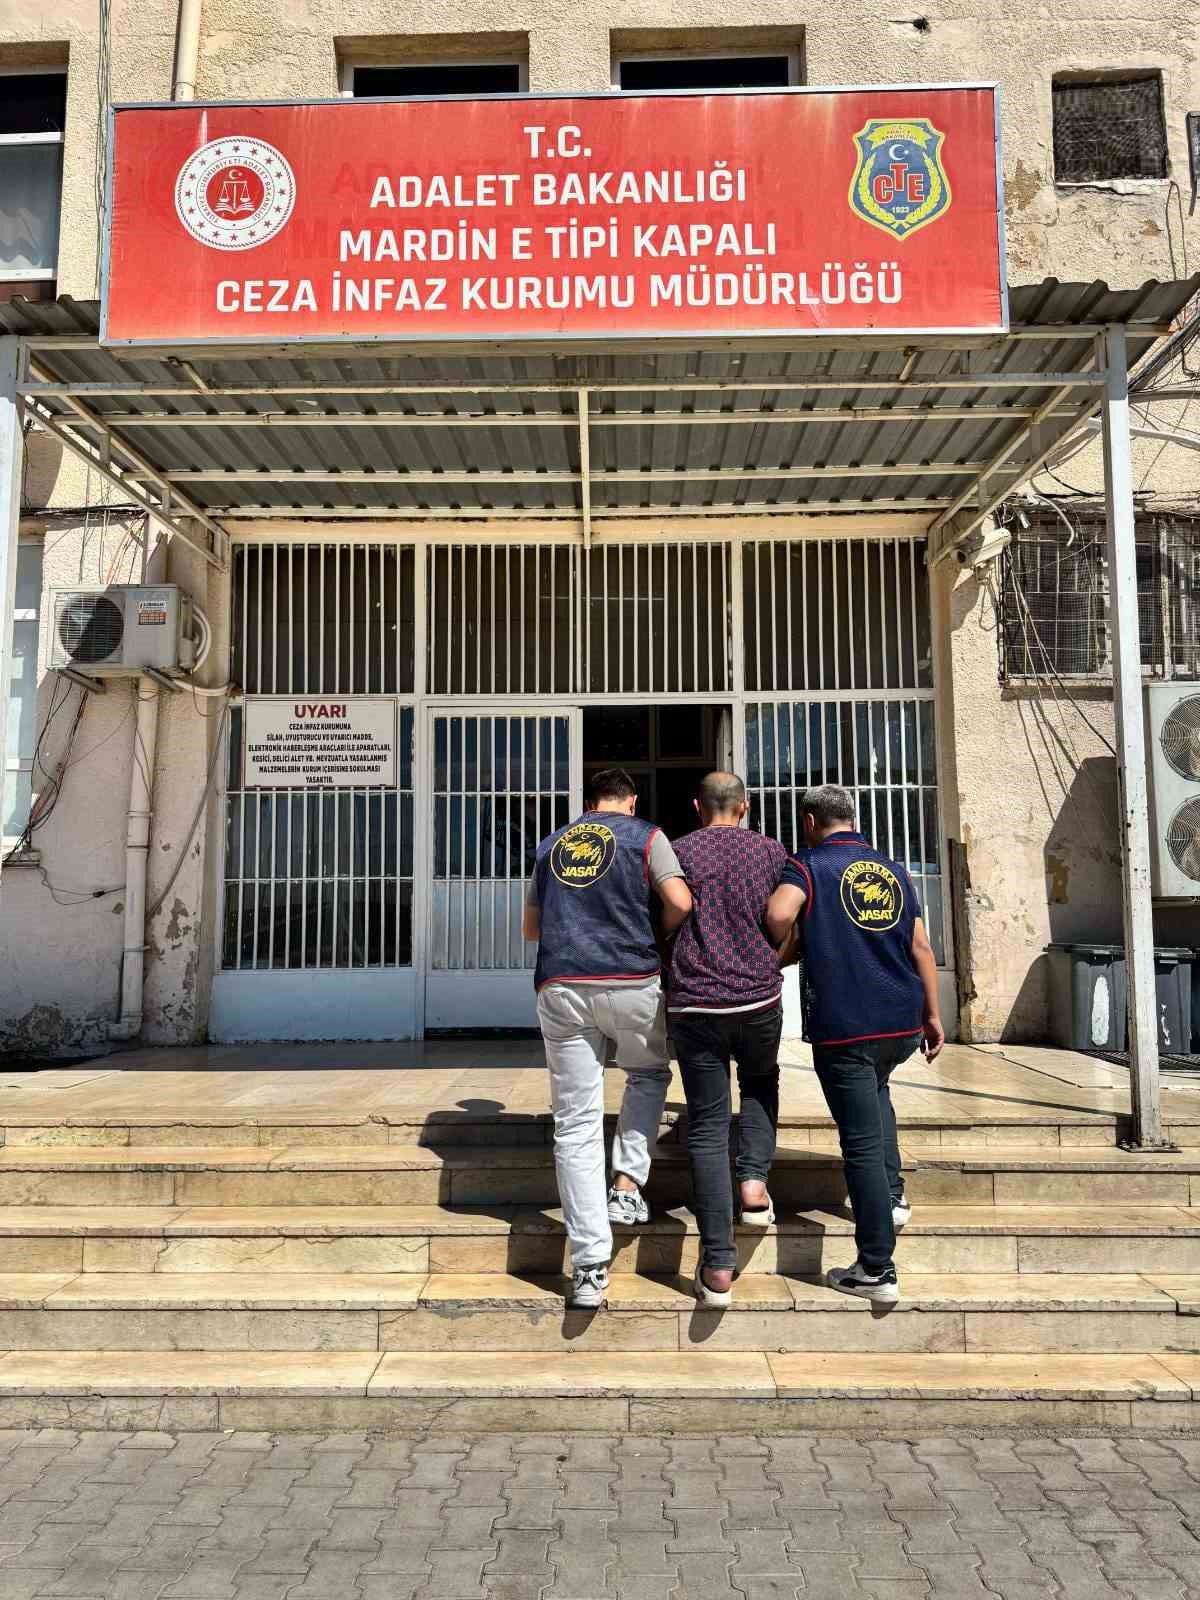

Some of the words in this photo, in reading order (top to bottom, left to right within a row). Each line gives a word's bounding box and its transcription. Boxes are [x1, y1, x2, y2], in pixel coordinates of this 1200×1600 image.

[523, 126, 591, 159] T.C.
[370, 174, 520, 208] ADALET
[532, 161, 746, 205] BAKANLIĞI
[339, 220, 496, 262] MARDİN
[512, 227, 533, 260] E
[545, 217, 619, 259] TİPİ
[633, 223, 777, 258] KAPALI
[216, 280, 318, 313] CEZA
[331, 271, 448, 312] İNFAZ
[462, 275, 635, 310] KURUMU
[650, 262, 903, 308] MÜDÜRLÜĞÜ
[294, 704, 347, 719] UYARI
[288, 723, 303, 731] CEZA
[321, 723, 352, 731] KURUMUNA
[291, 754, 305, 763] ALET
[316, 754, 349, 763] MEVZUATLA
[302, 765, 323, 774] KURUM
[562, 865, 600, 877] JASAT
[844, 862, 896, 885] JANDARMA
[858, 909, 894, 921] JASAT
